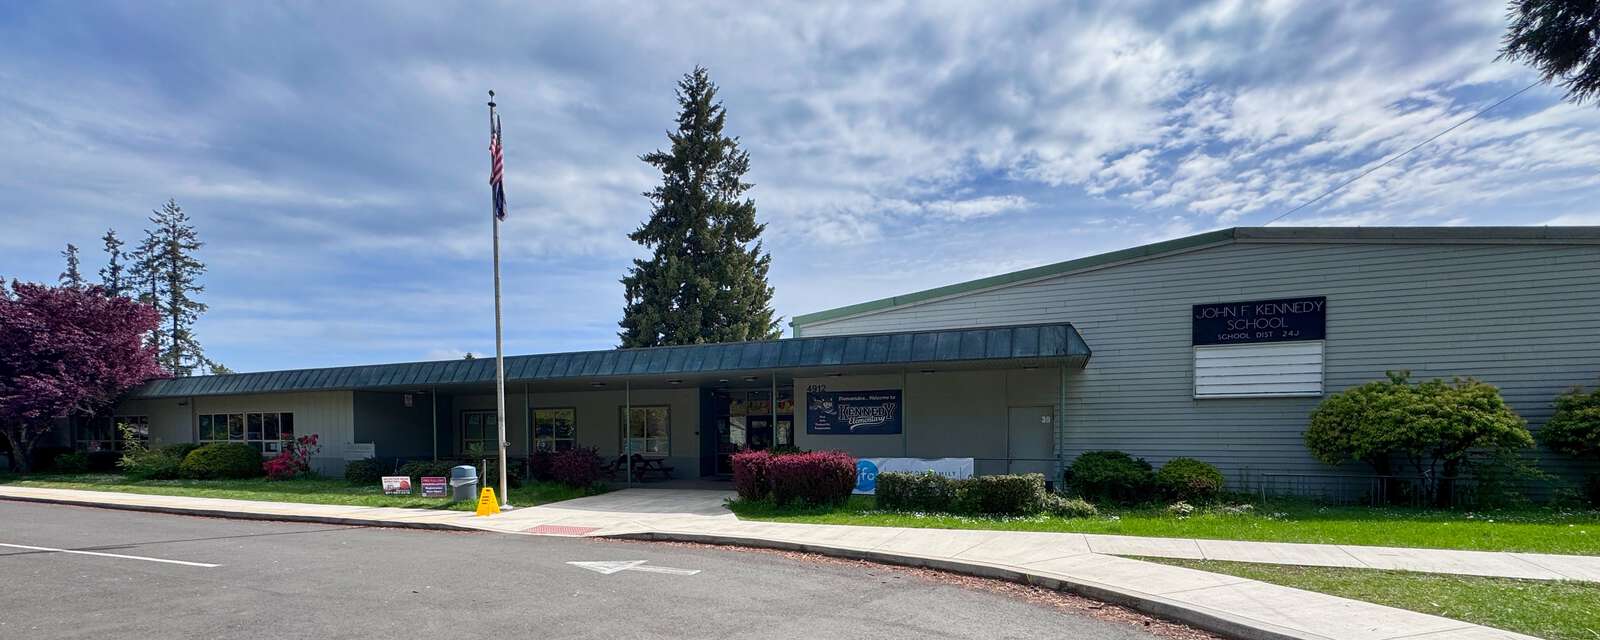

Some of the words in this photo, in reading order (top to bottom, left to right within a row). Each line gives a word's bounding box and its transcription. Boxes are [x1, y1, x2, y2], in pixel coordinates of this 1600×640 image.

[1195, 306, 1236, 319] JOHN
[1241, 305, 1249, 316] F
[1255, 300, 1324, 316] KENNEDY
[1226, 317, 1288, 331] SCHOOL
[1217, 332, 1250, 340] SCHOOL
[1256, 331, 1273, 339] DIST
